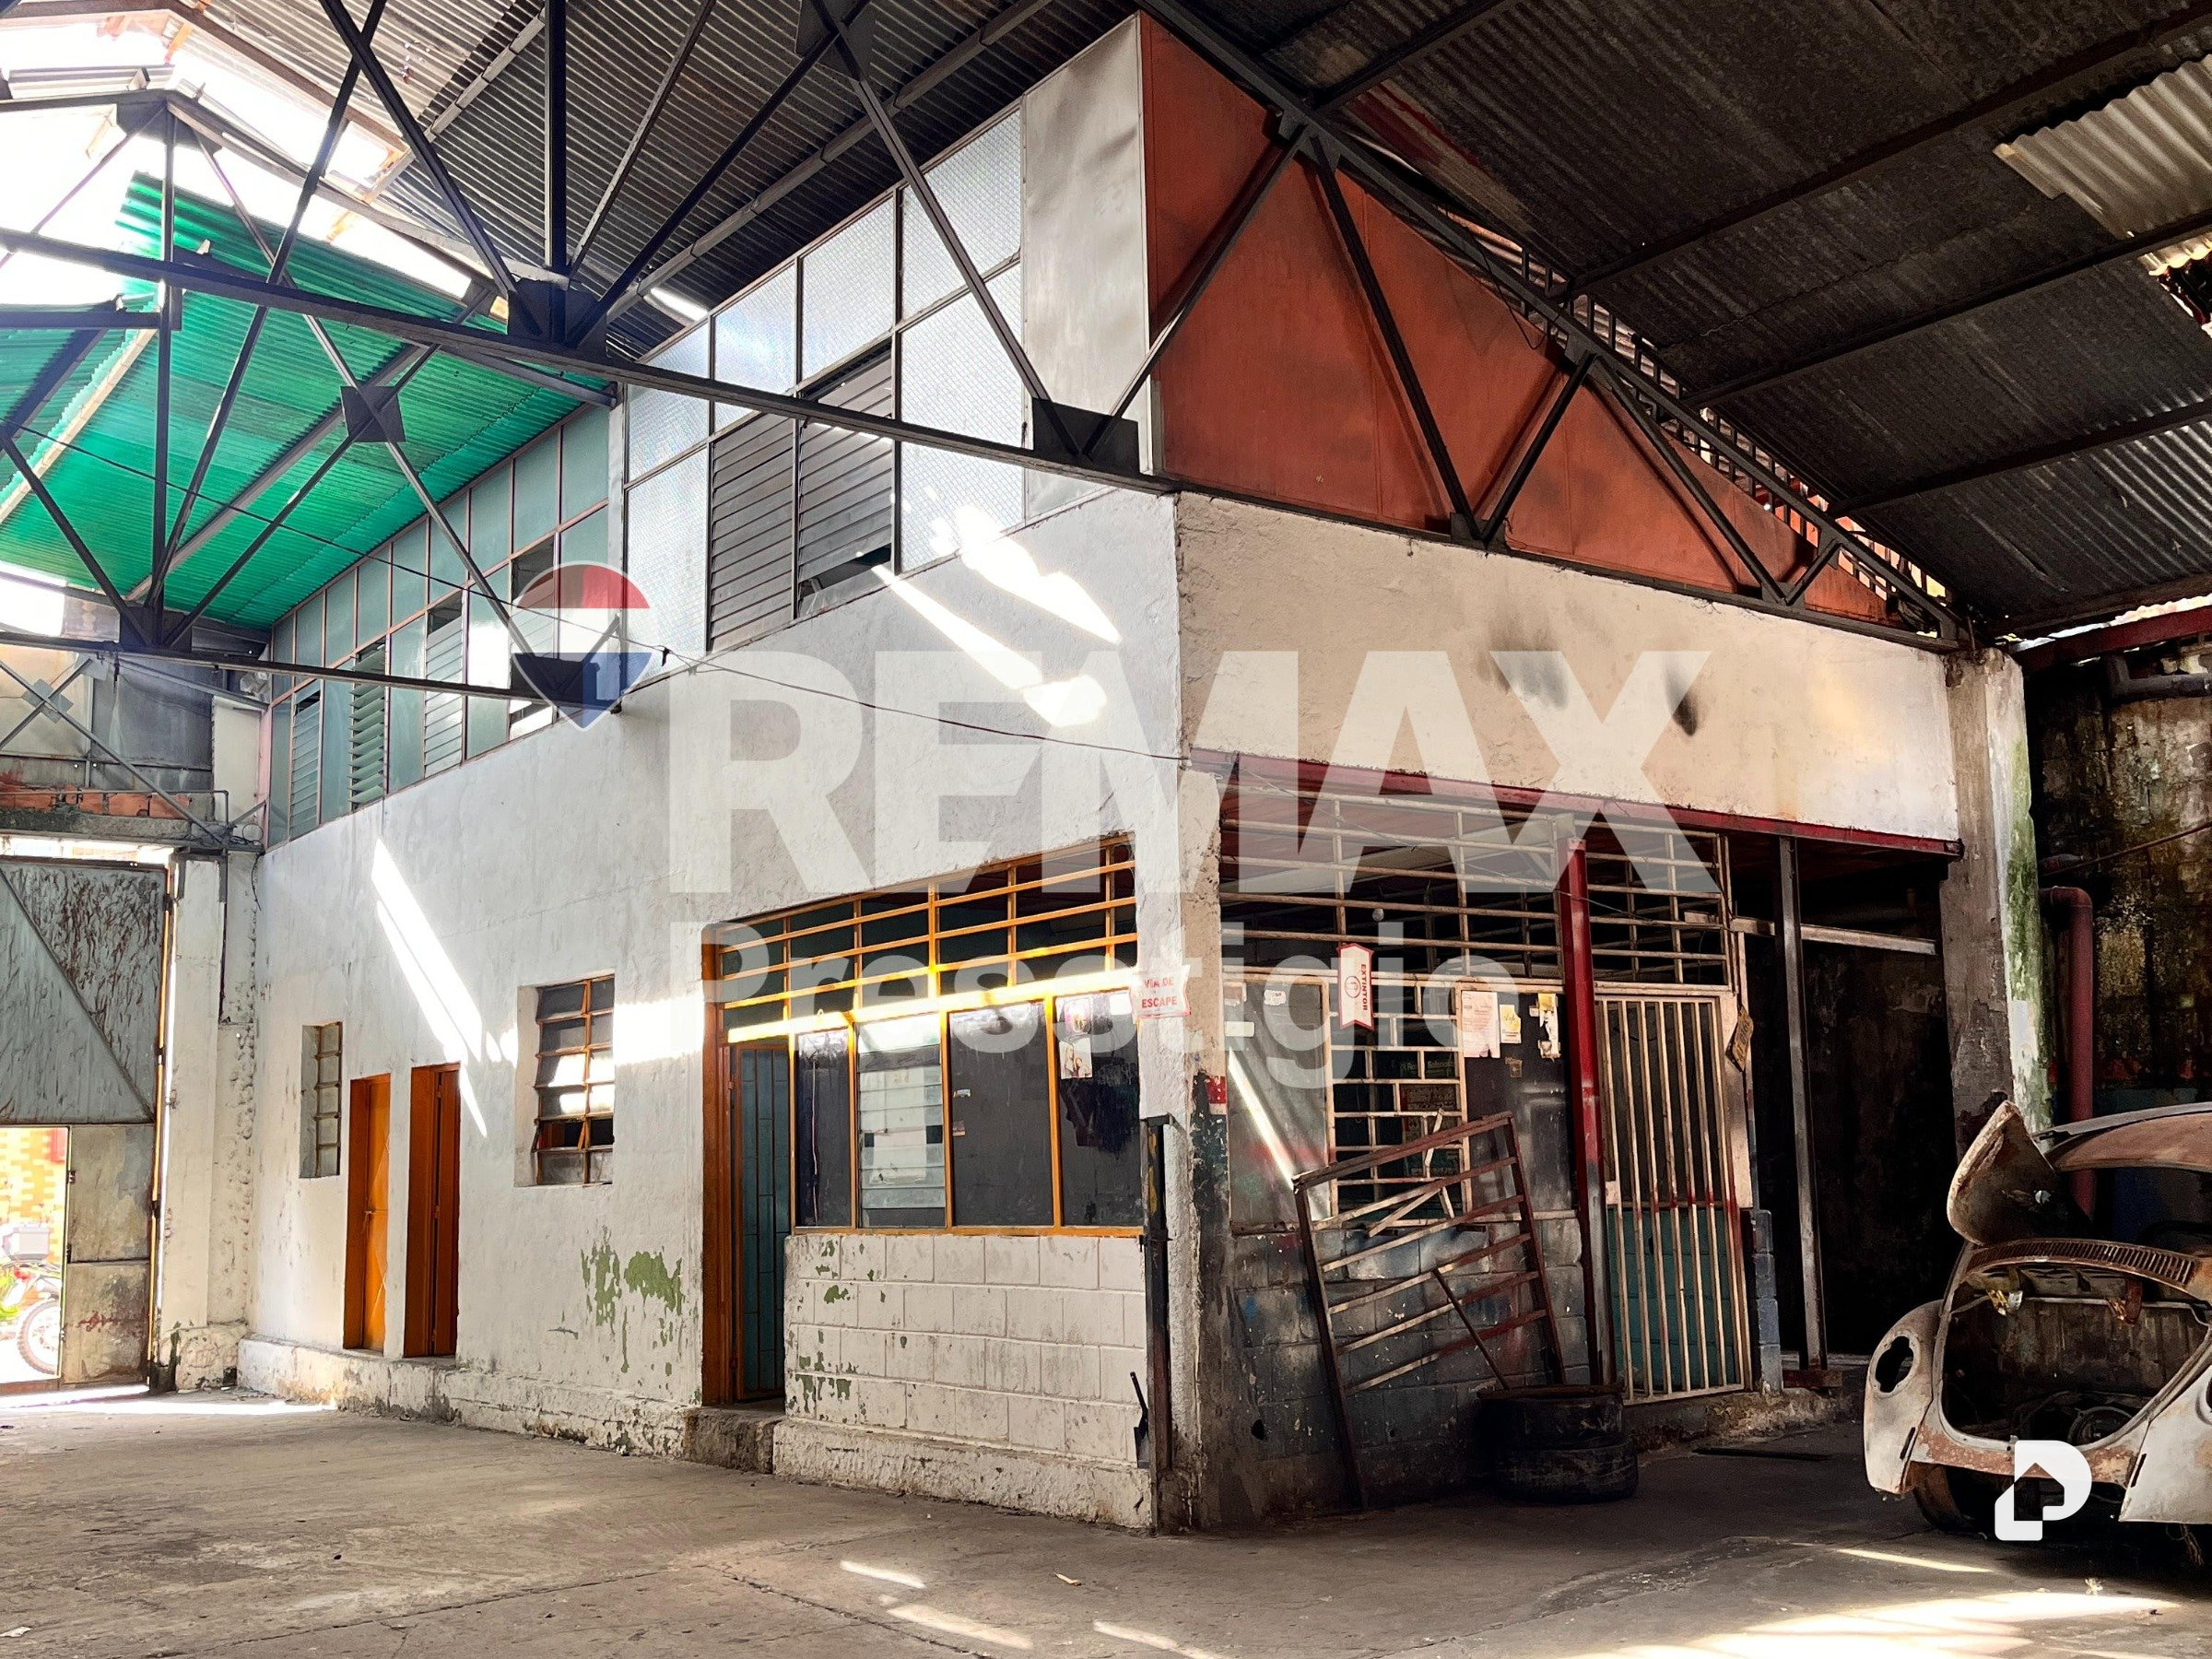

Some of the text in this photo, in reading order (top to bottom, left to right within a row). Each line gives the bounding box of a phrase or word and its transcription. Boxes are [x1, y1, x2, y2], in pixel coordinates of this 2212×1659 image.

[1162, 977, 1174, 987] DE
[1360, 963, 1369, 1011] EXTINTOR
[1141, 995, 1177, 1009] ESCAPE
